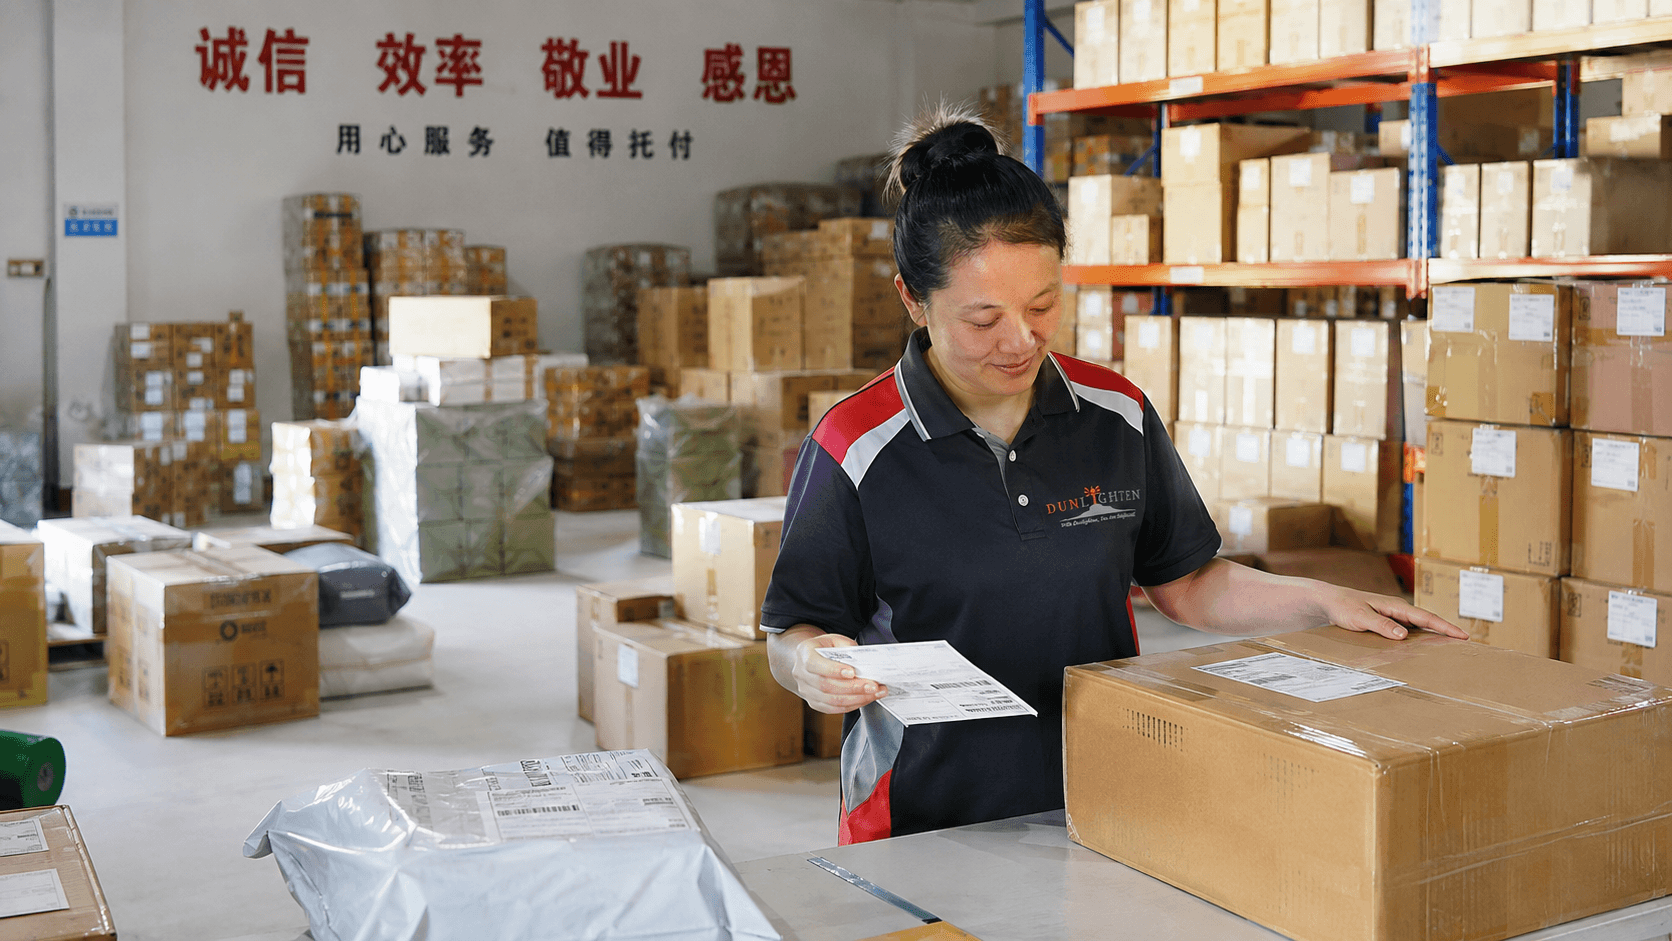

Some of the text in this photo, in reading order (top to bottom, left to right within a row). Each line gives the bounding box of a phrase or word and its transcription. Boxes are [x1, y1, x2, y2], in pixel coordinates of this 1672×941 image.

[195, 26, 797, 104] 诚信 效率 敬业 感恩
[336, 124, 694, 161] 用心服务 值得托付
[1045, 487, 1141, 515] DUNLIGHTEN
